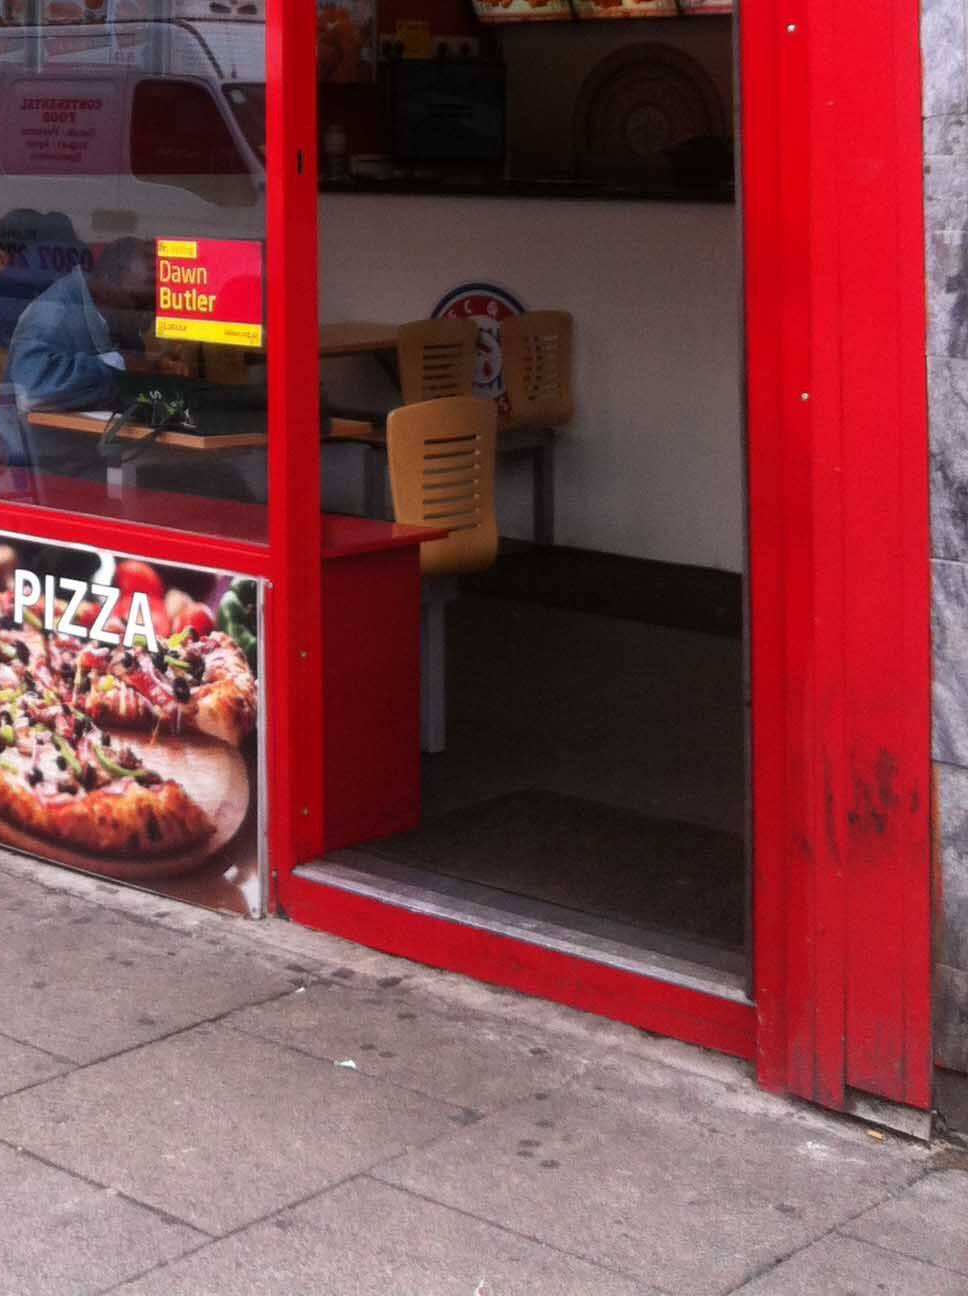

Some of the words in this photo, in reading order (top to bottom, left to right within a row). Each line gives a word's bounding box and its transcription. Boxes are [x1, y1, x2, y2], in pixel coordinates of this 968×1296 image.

[159, 260, 207, 285] Dawn
[159, 286, 217, 313] Butler
[12, 569, 159, 654] PIZZA
